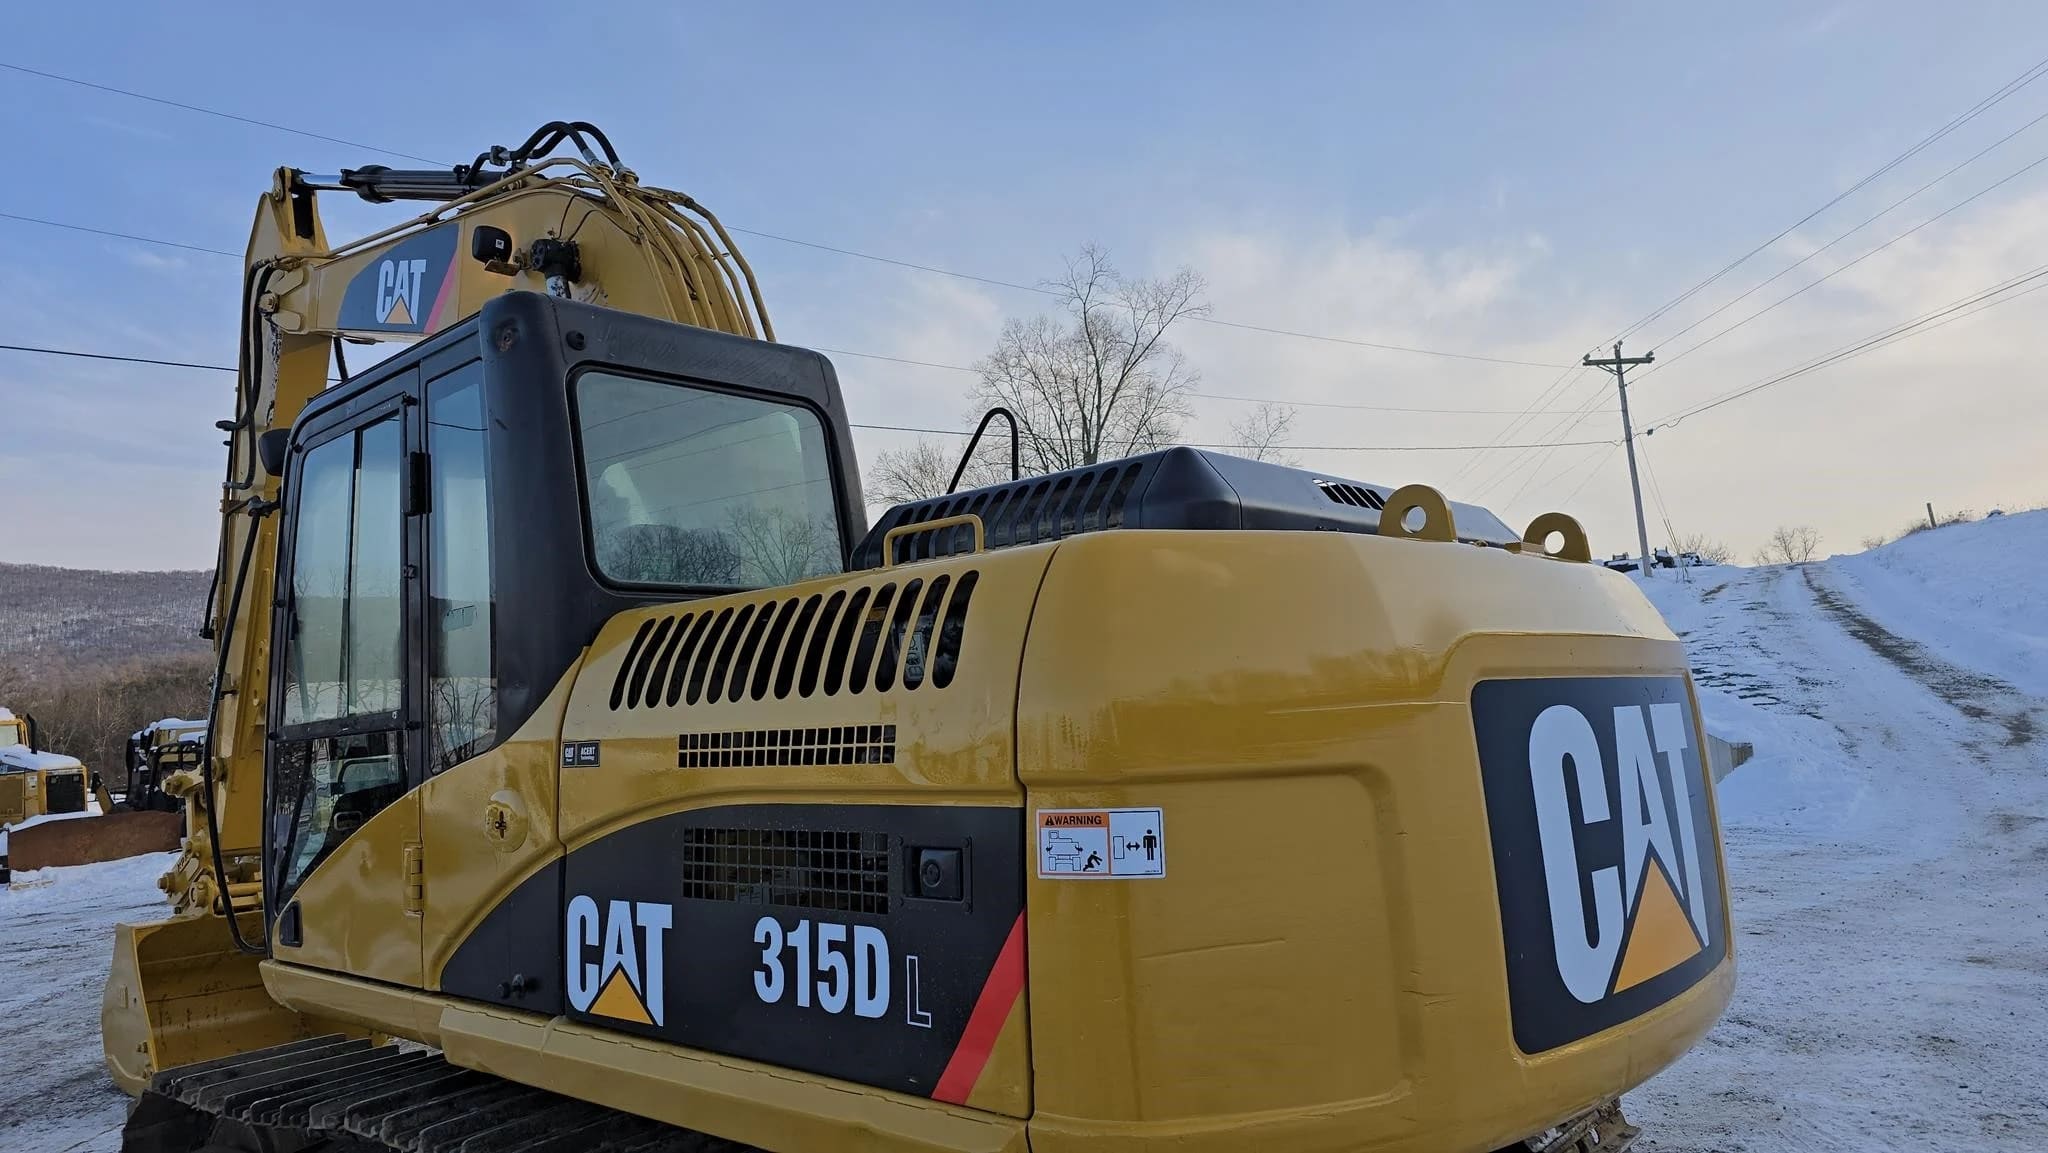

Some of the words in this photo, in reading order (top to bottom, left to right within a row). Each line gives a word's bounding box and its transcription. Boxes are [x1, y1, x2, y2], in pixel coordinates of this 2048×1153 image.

[376, 259, 427, 325] CAT
[1053, 815, 1102, 826] WARNING
[1528, 702, 1710, 1004] CAT
[566, 895, 673, 1027] CAT
[753, 916, 891, 1019] 315D
[906, 954, 932, 1029] L
